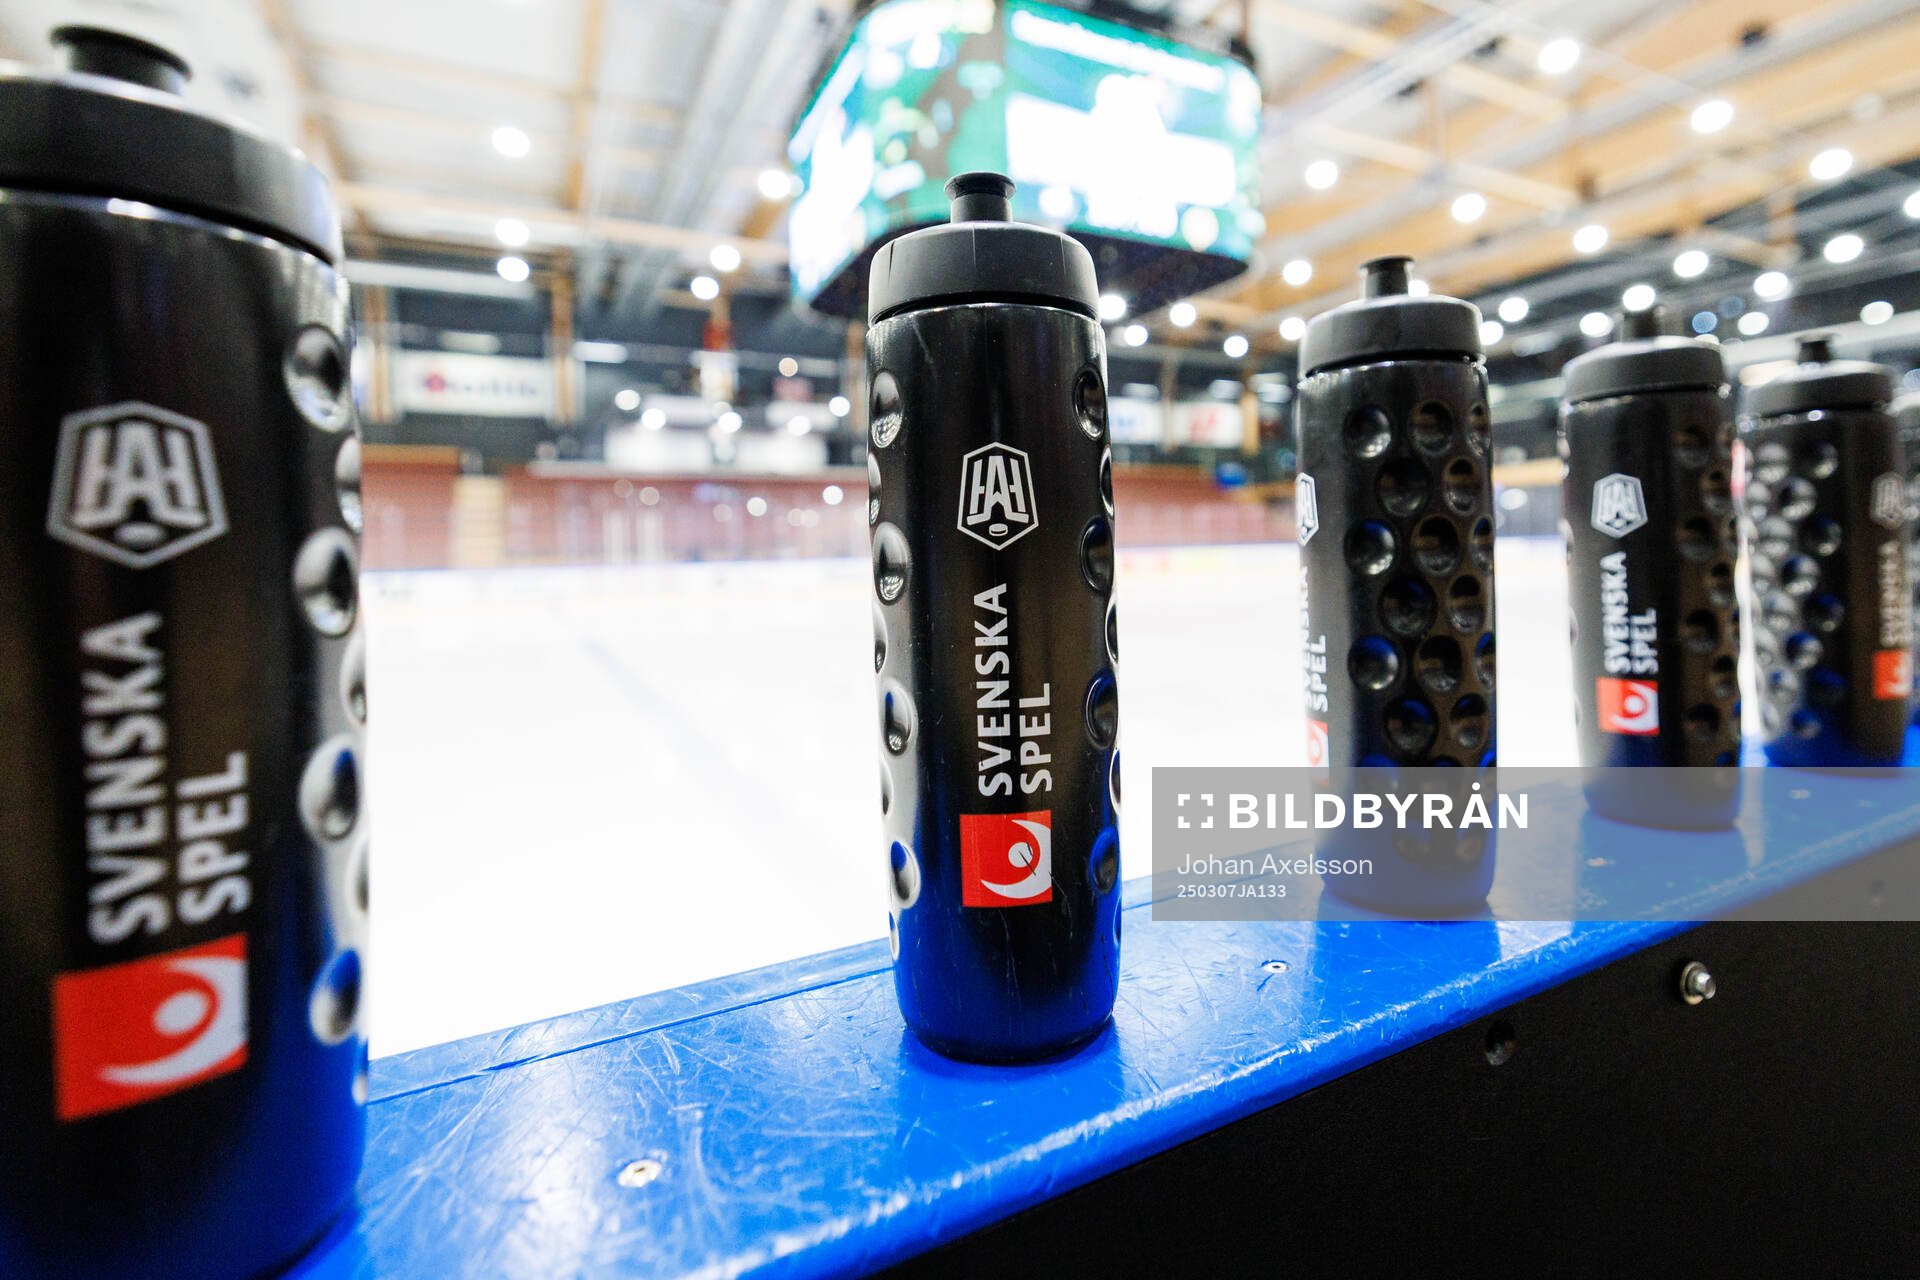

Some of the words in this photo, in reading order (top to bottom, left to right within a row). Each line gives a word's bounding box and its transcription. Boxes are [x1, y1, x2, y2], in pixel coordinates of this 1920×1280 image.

[1307, 635, 1329, 713] SPEL
[1600, 551, 1632, 674] SVENSKA
[1630, 607, 1659, 675] SPEL
[973, 583, 1012, 796] SVENSKA
[1019, 683, 1052, 794] SPEL
[83, 611, 170, 946] SVENSKA
[176, 751, 250, 925] SPEL
